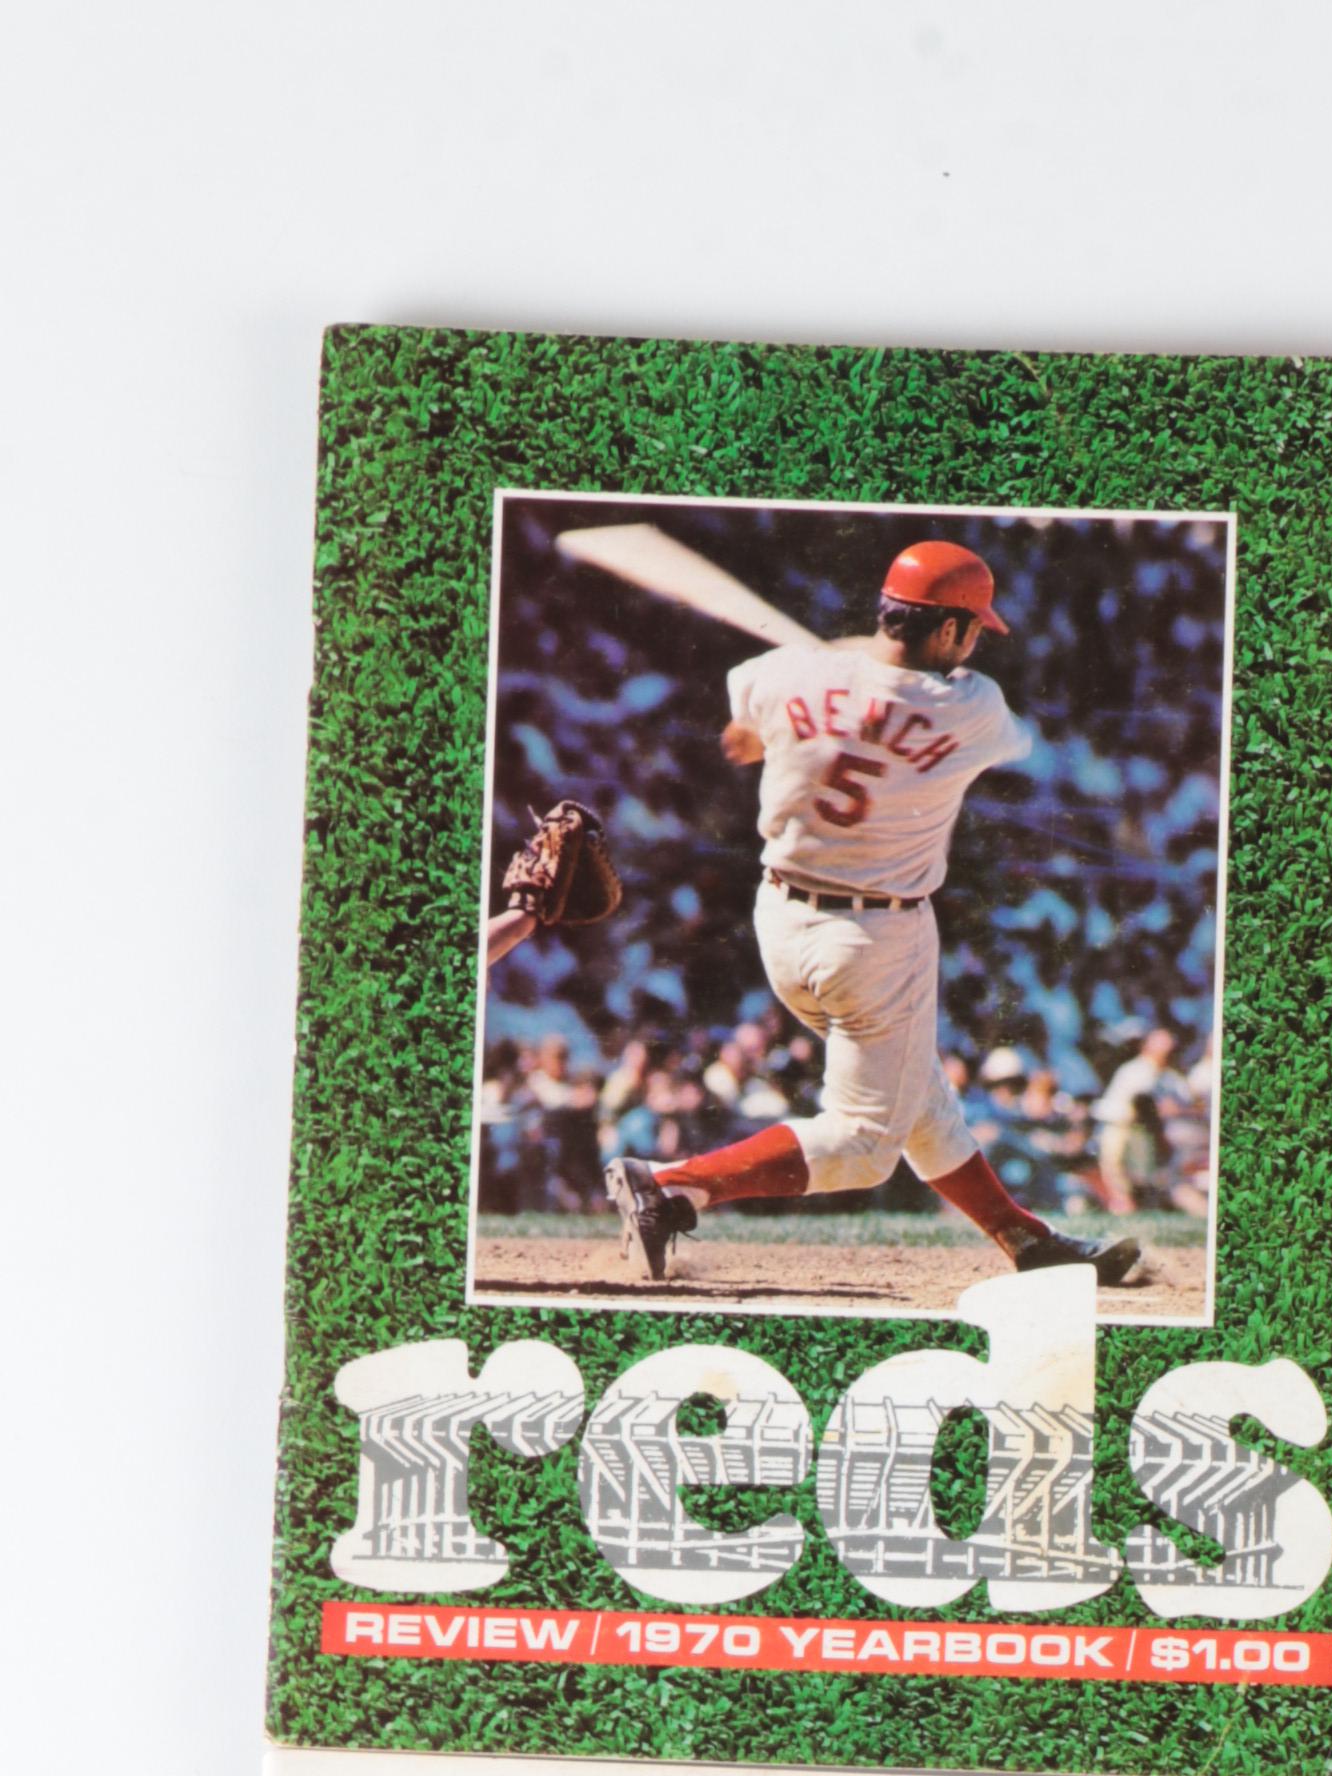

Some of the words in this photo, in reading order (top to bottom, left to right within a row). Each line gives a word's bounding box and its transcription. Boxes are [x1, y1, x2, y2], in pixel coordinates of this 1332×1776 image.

[786, 688, 959, 773] BENCH
[815, 752, 888, 827] 5
[345, 1612, 579, 1651] REVIEW
[616, 1620, 762, 1657] 1970
[779, 1625, 1113, 1668] YEARBOOK
[1151, 1636, 1311, 1673] $1.00
